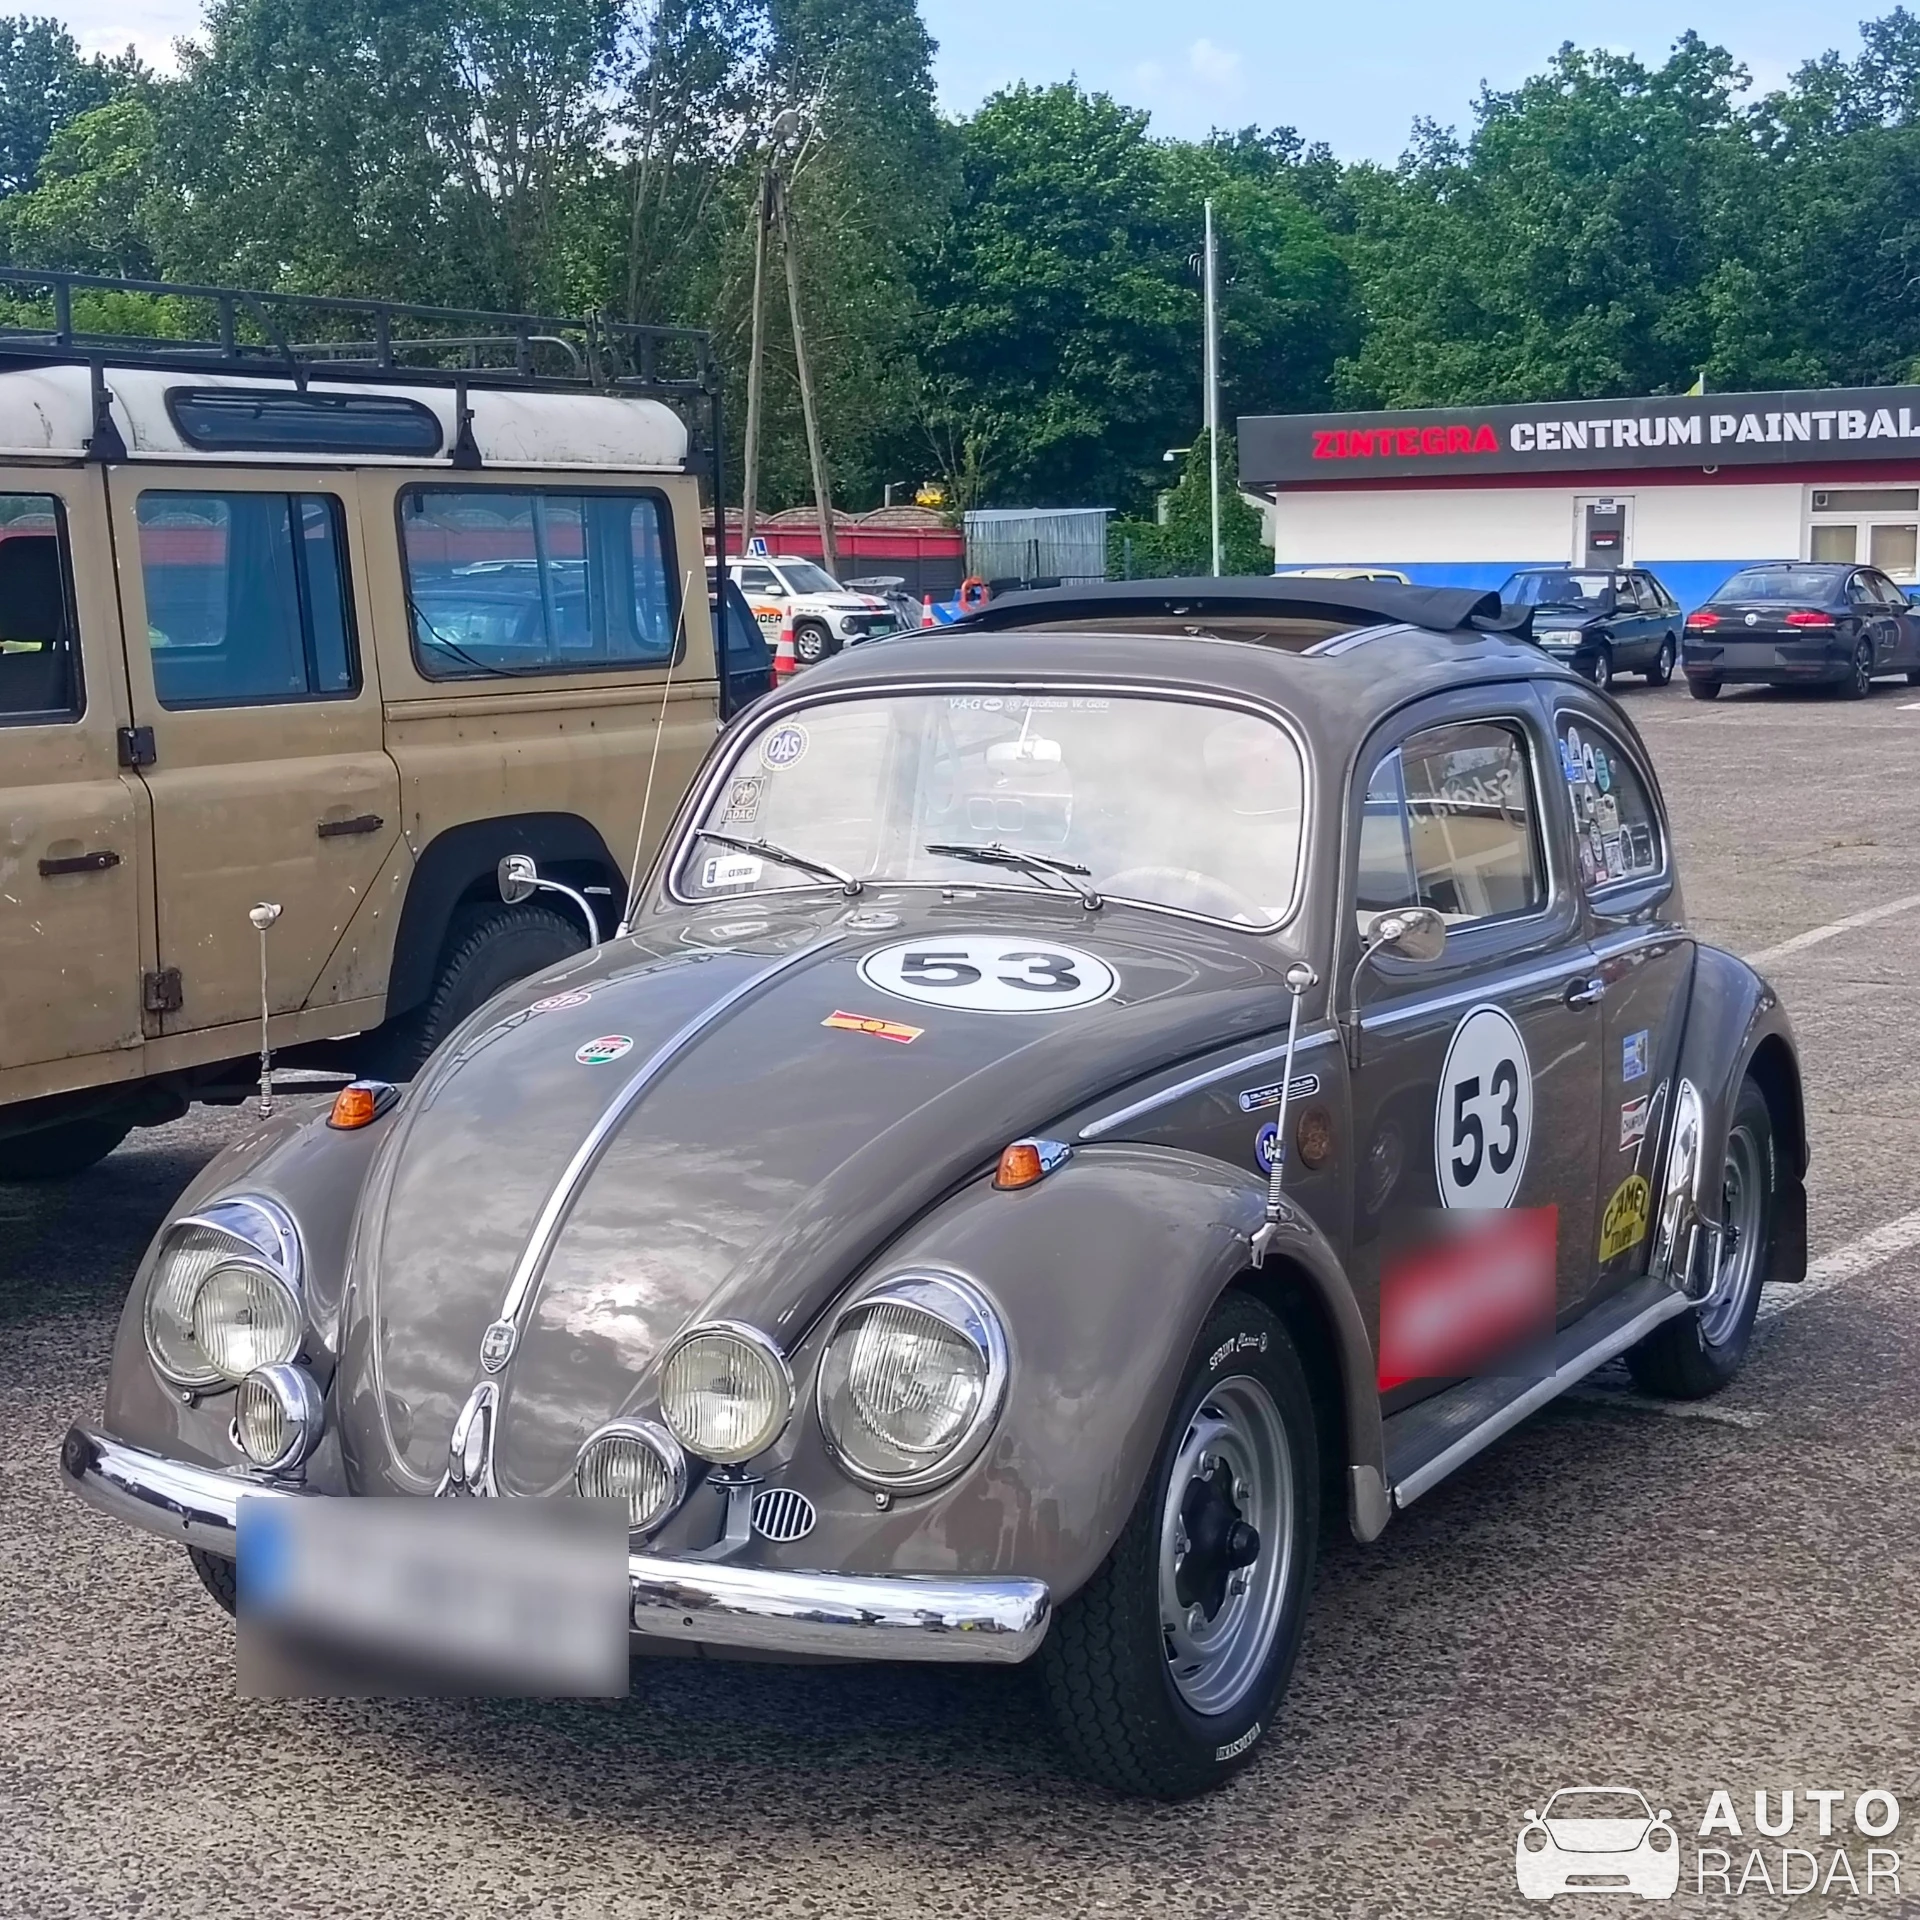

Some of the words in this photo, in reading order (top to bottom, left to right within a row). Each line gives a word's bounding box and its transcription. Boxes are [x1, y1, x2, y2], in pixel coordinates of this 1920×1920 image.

[1312, 424, 1499, 459] ZINTEGRA
[1510, 416, 1701, 452] CENTRUM
[1710, 407, 1920, 444] PAINTBAL
[756, 540, 765, 555] L
[768, 734, 801, 761] DAS
[725, 808, 755, 821] ADAC
[900, 952, 1081, 993] 53
[535, 993, 583, 1010] STP
[1452, 1058, 1519, 1188] 53
[1604, 1182, 1646, 1239] CAMEL
[1209, 1337, 1235, 1371] SPRINT
